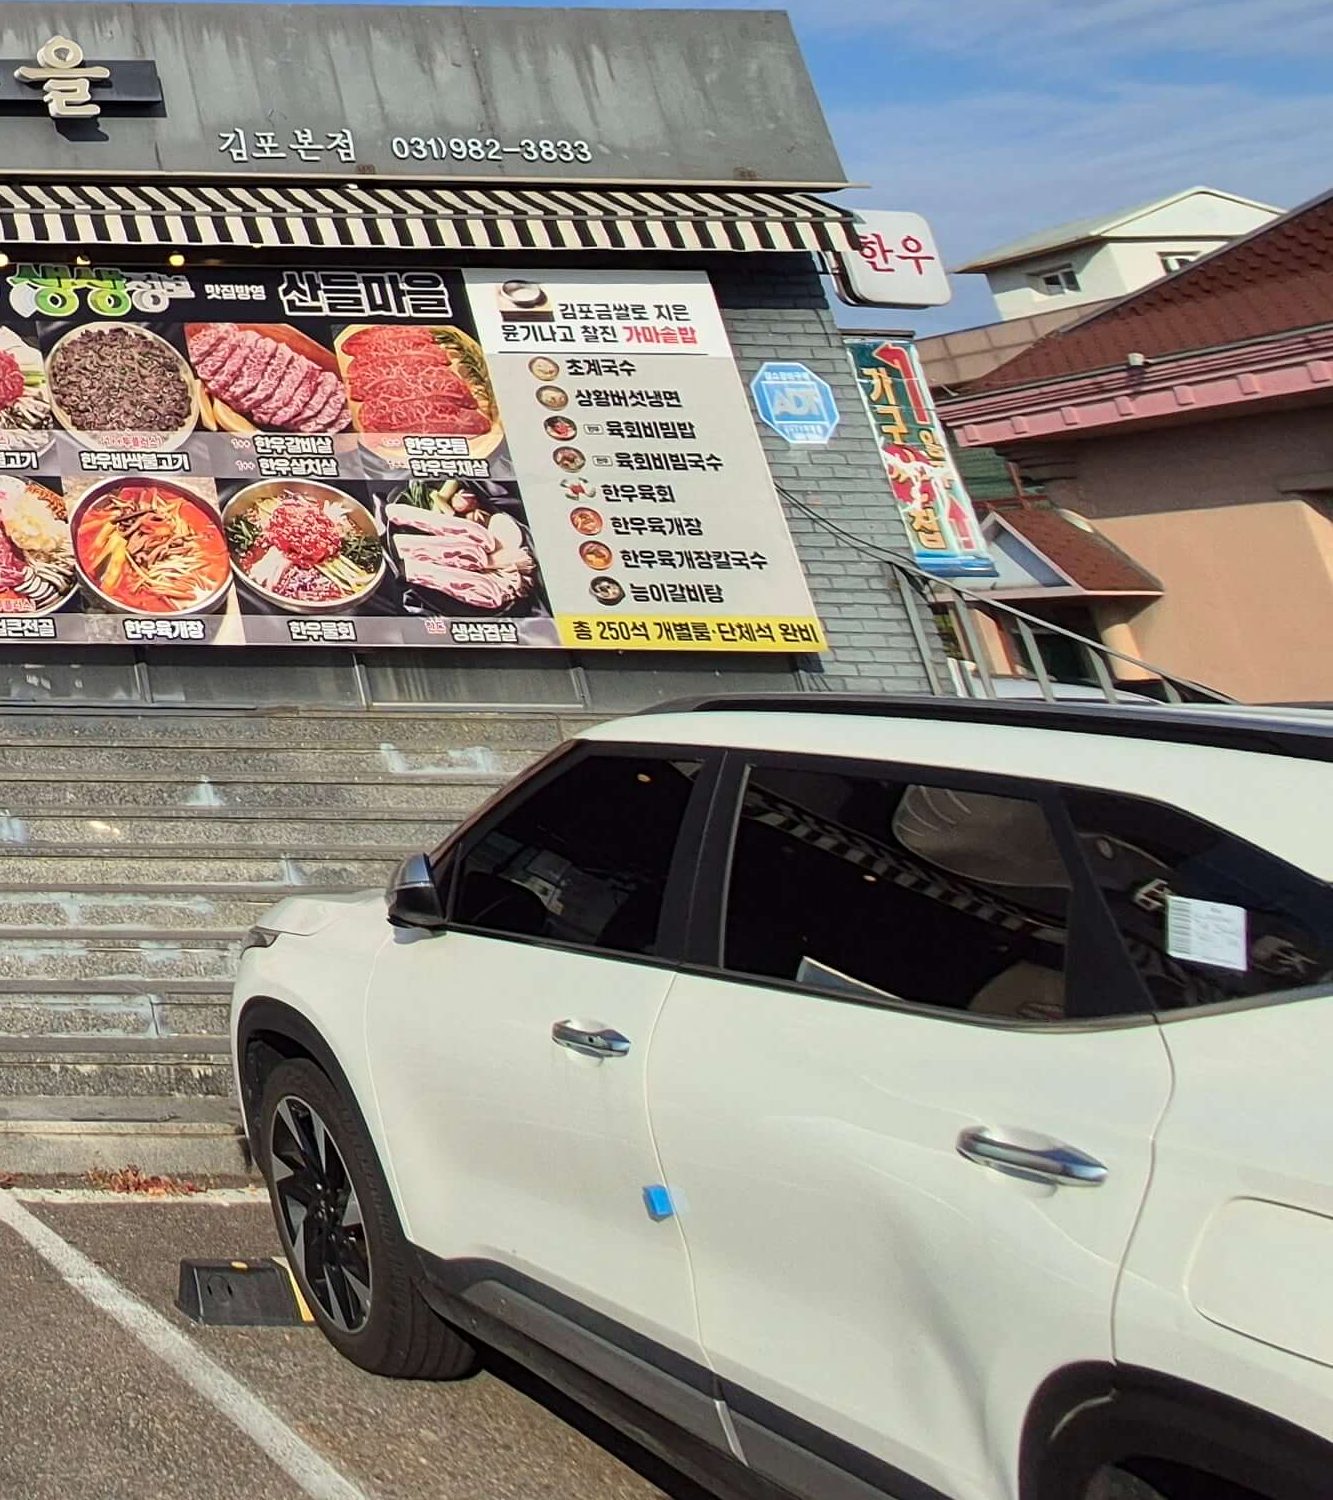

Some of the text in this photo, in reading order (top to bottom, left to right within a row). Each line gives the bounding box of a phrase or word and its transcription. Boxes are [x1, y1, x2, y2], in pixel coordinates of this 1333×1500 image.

[218, 128, 592, 163] 김포본점 031)982-3833
[859, 233, 934, 275] 한우
[204, 283, 265, 301] 맛집방영
[279, 271, 453, 317] 산들마을
[559, 303, 690, 322] 김포금쌀로 지은
[501, 324, 699, 345] 윤기나고 찰진 가마솥밥
[565, 359, 637, 377] 초계국수
[575, 389, 683, 408] 상황버섯냉면
[606, 421, 696, 440] 육회비빔밥
[253, 435, 333, 455] 한우갈비살
[403, 436, 470, 455] 한우모듬
[80, 451, 191, 471] 한우바싹불고기
[257, 457, 339, 477] 한우살치살
[409, 459, 489, 478] 한우부채살
[616, 452, 724, 472] 육회비빔국수
[602, 484, 676, 503] 한우육회
[610, 516, 703, 536] 한우육개장
[620, 550, 768, 570] 한우육개장칼국수
[630, 583, 725, 603] 능이갈비탕
[123, 619, 204, 640] 한우육개장
[287, 620, 357, 642] 한우물회
[450, 621, 517, 644] 생삼겹살
[573, 621, 592, 640] 총
[596, 621, 650, 641] 250석
[779, 624, 821, 644] 완비
